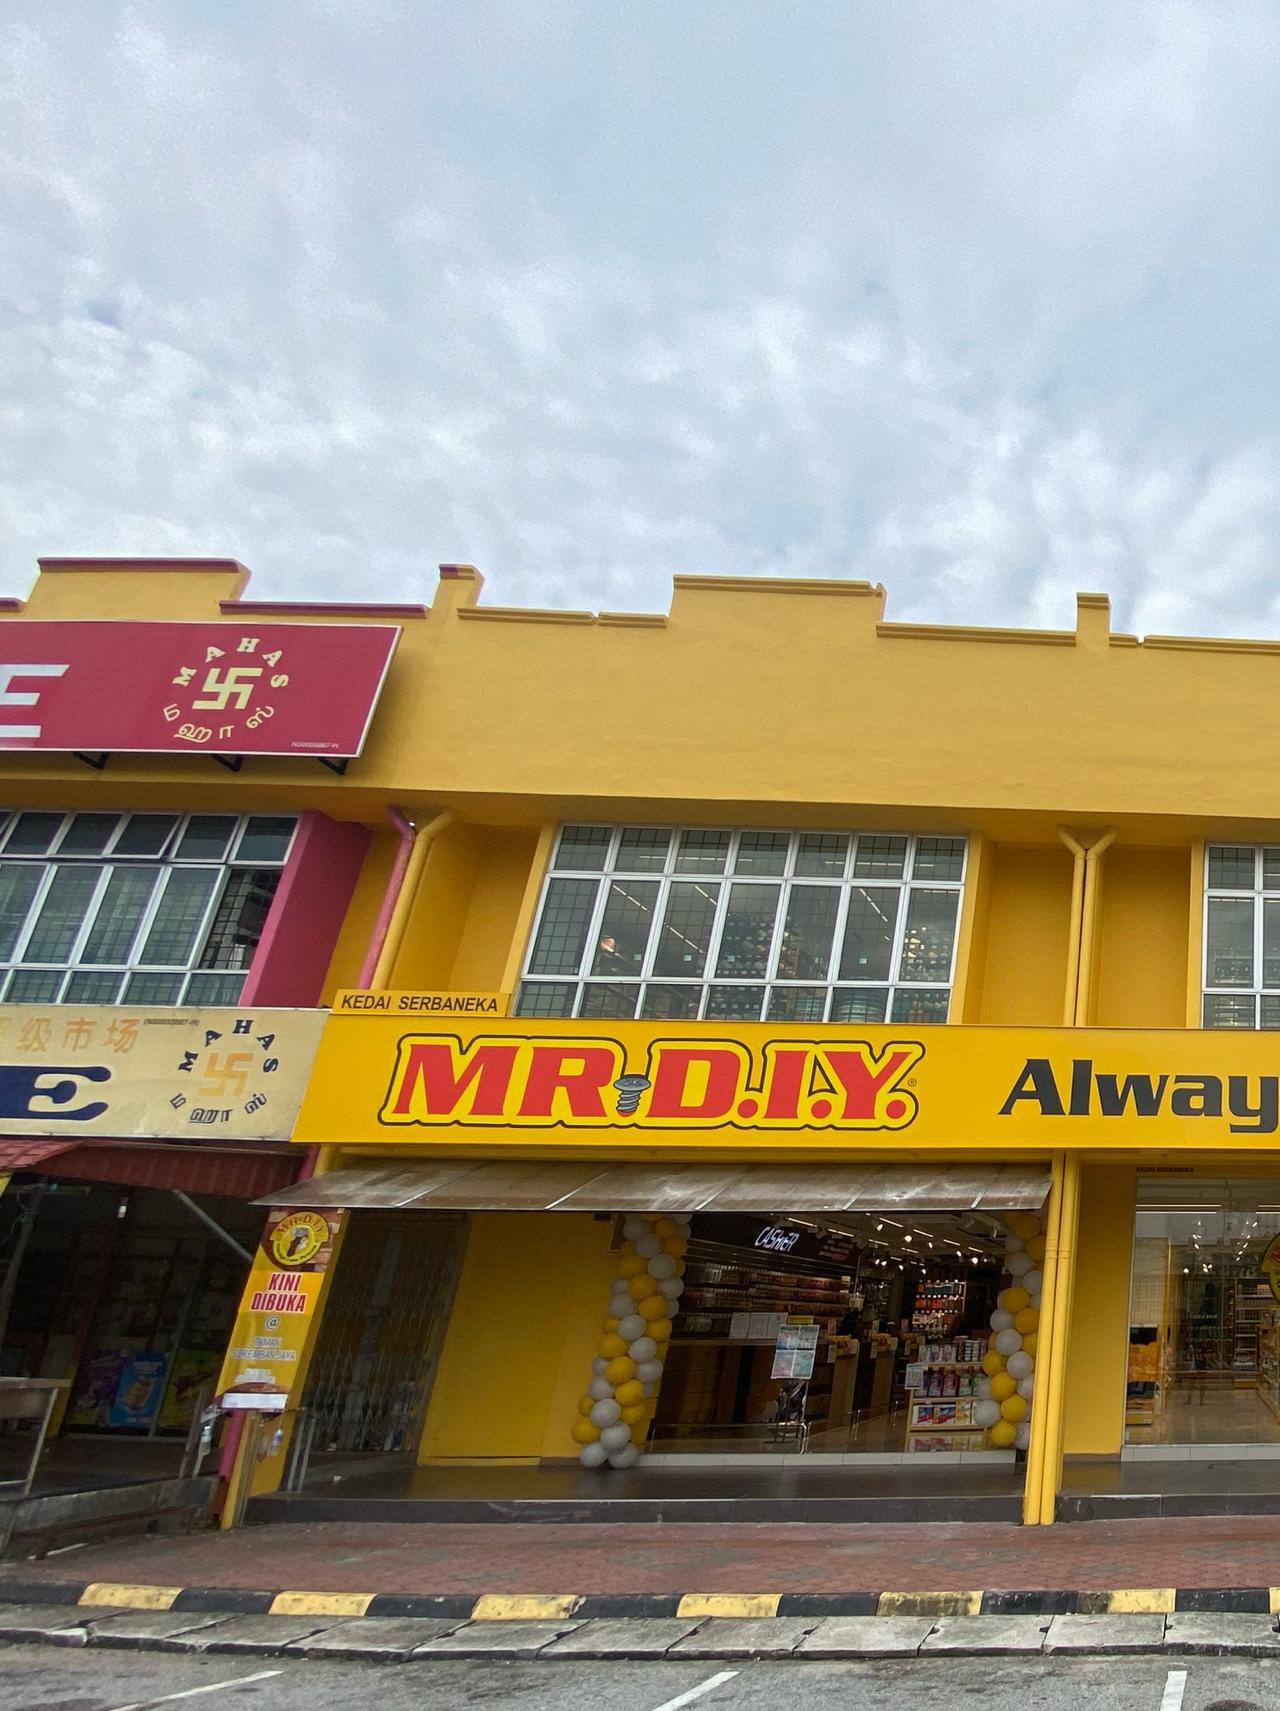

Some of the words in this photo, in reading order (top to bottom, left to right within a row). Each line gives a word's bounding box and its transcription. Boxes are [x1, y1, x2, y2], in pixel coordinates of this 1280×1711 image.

[172, 637, 289, 688] MAHAS
[341, 995, 392, 1010] KEDAI
[398, 996, 498, 1012] SERBANEKA
[178, 1019, 279, 1073] MAHAS
[267, 1272, 303, 1292] KINI
[250, 1292, 307, 1312] DIBUKA
